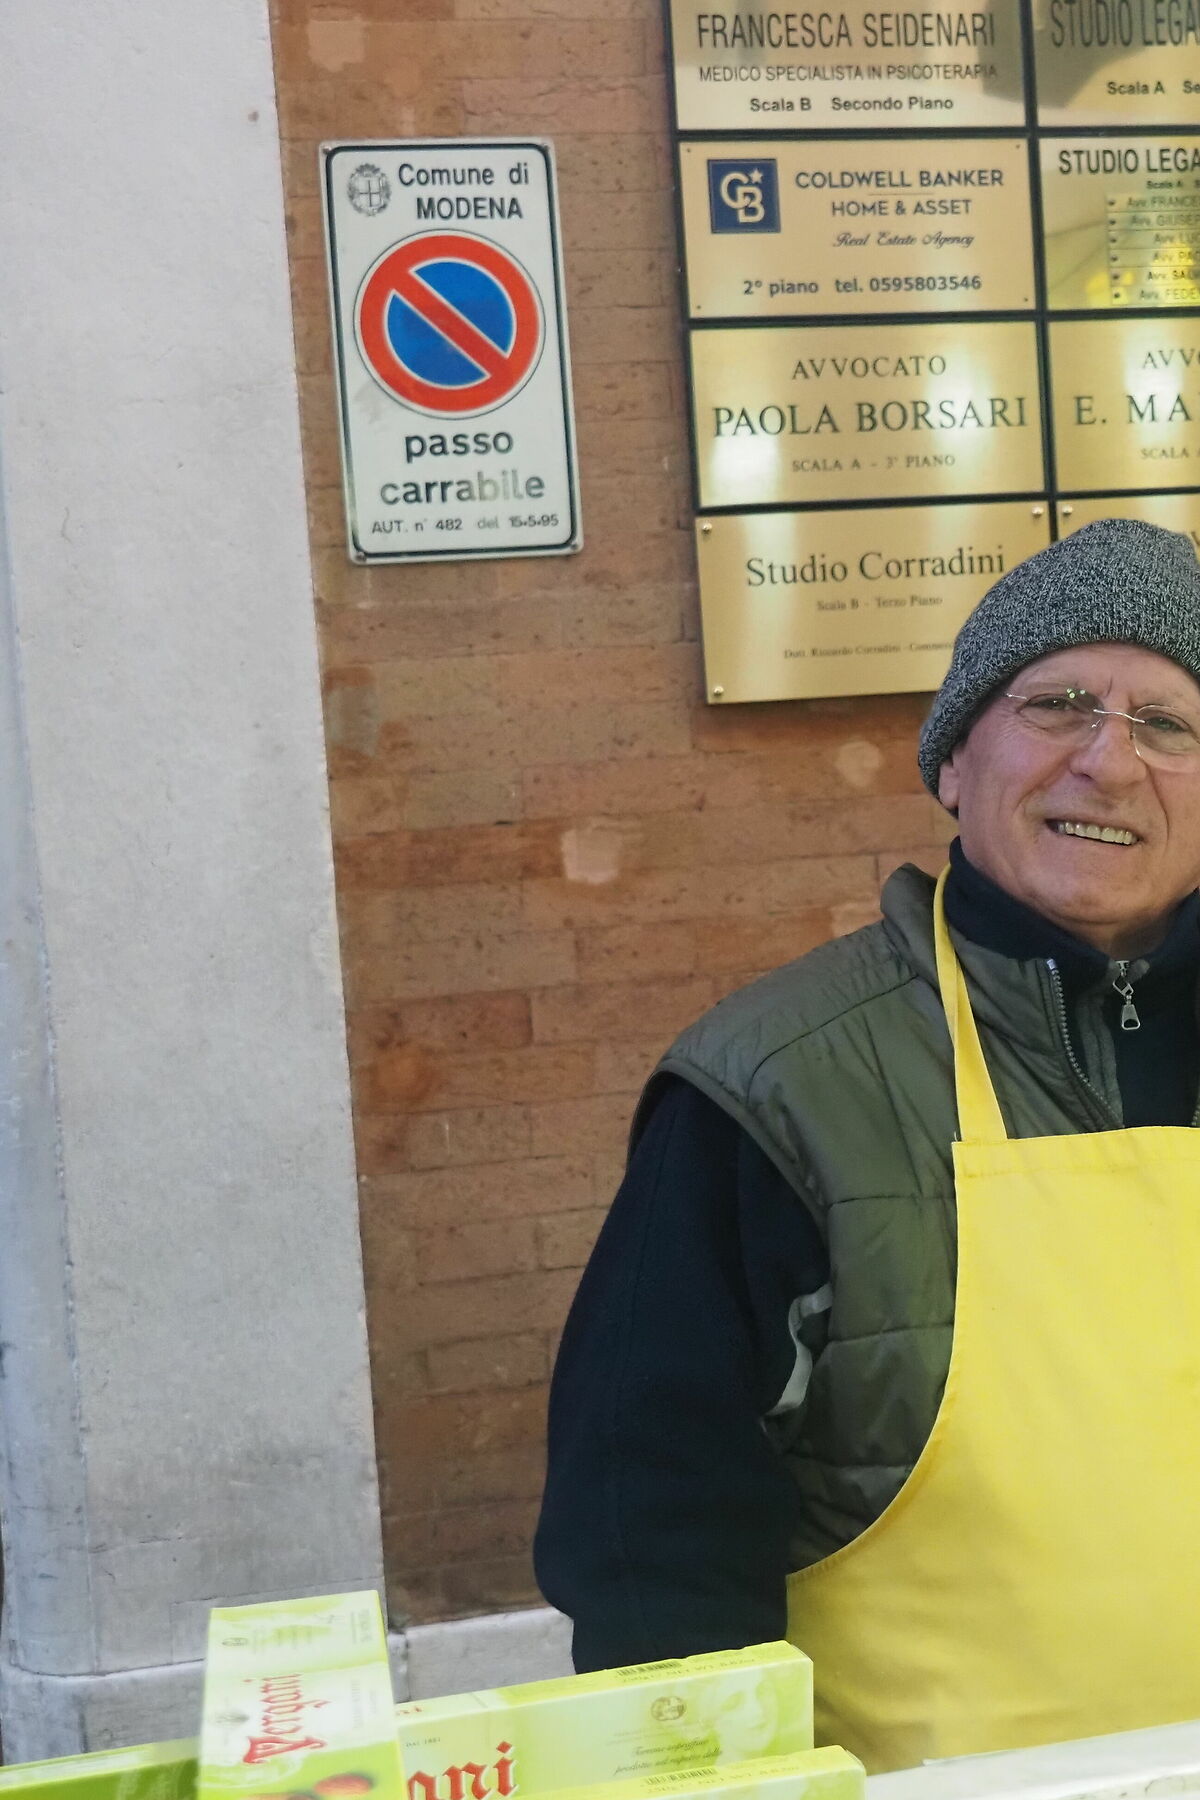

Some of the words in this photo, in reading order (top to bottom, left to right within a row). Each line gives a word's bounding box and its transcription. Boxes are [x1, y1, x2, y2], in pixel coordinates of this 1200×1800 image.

[697, 13, 852, 49] FRANCESCA
[864, 13, 996, 48] SEIDENARI
[1050, 0, 1133, 48] STUDIO
[699, 66, 761, 82] MEDICO
[765, 65, 865, 82] SPECIALISTA
[867, 65, 883, 80] IN
[887, 63, 998, 80] PSICOTERAPIA
[1107, 82, 1149, 96] Scala
[1153, 82, 1165, 95] A
[750, 98, 795, 113] Scala
[800, 98, 812, 111] B
[832, 97, 903, 111] Secondo
[908, 97, 955, 110] Piano
[1058, 149, 1140, 175] STUDIO
[398, 163, 495, 187] Comune
[509, 162, 529, 184] di
[795, 171, 912, 189] COLDWELL
[920, 169, 1004, 188] BANKER
[1146, 180, 1174, 190] Scala
[416, 197, 524, 220] MODENA
[832, 201, 889, 217] HOME
[895, 201, 907, 215] &
[913, 199, 972, 215] ASSET
[833, 233, 870, 248] Real
[877, 231, 916, 246] Estate
[923, 231, 974, 250] Agency
[769, 280, 819, 297] piano
[835, 277, 864, 293] tel.
[870, 275, 982, 293] 0595803546
[792, 355, 947, 381] AVVOCATO
[713, 403, 840, 438] PAOLA
[856, 396, 1028, 433] BORSARI
[1073, 395, 1107, 426] E.
[404, 430, 514, 463] passo
[1140, 446, 1189, 460] SCALA
[791, 457, 843, 473] SCALA
[851, 457, 862, 471] A
[904, 454, 956, 468] PIANO
[379, 468, 546, 505] carrabile
[371, 518, 408, 535] AUT.
[435, 517, 464, 531] 482
[477, 515, 499, 530] del
[746, 553, 848, 587] Studio
[858, 546, 1005, 580] Corradini
[817, 600, 846, 611] Scala
[850, 598, 860, 609] B
[875, 597, 907, 608] Terzo
[909, 594, 943, 607] Piano
[242, 1672, 333, 1764] Vergani
[407, 1740, 519, 1800] ani
